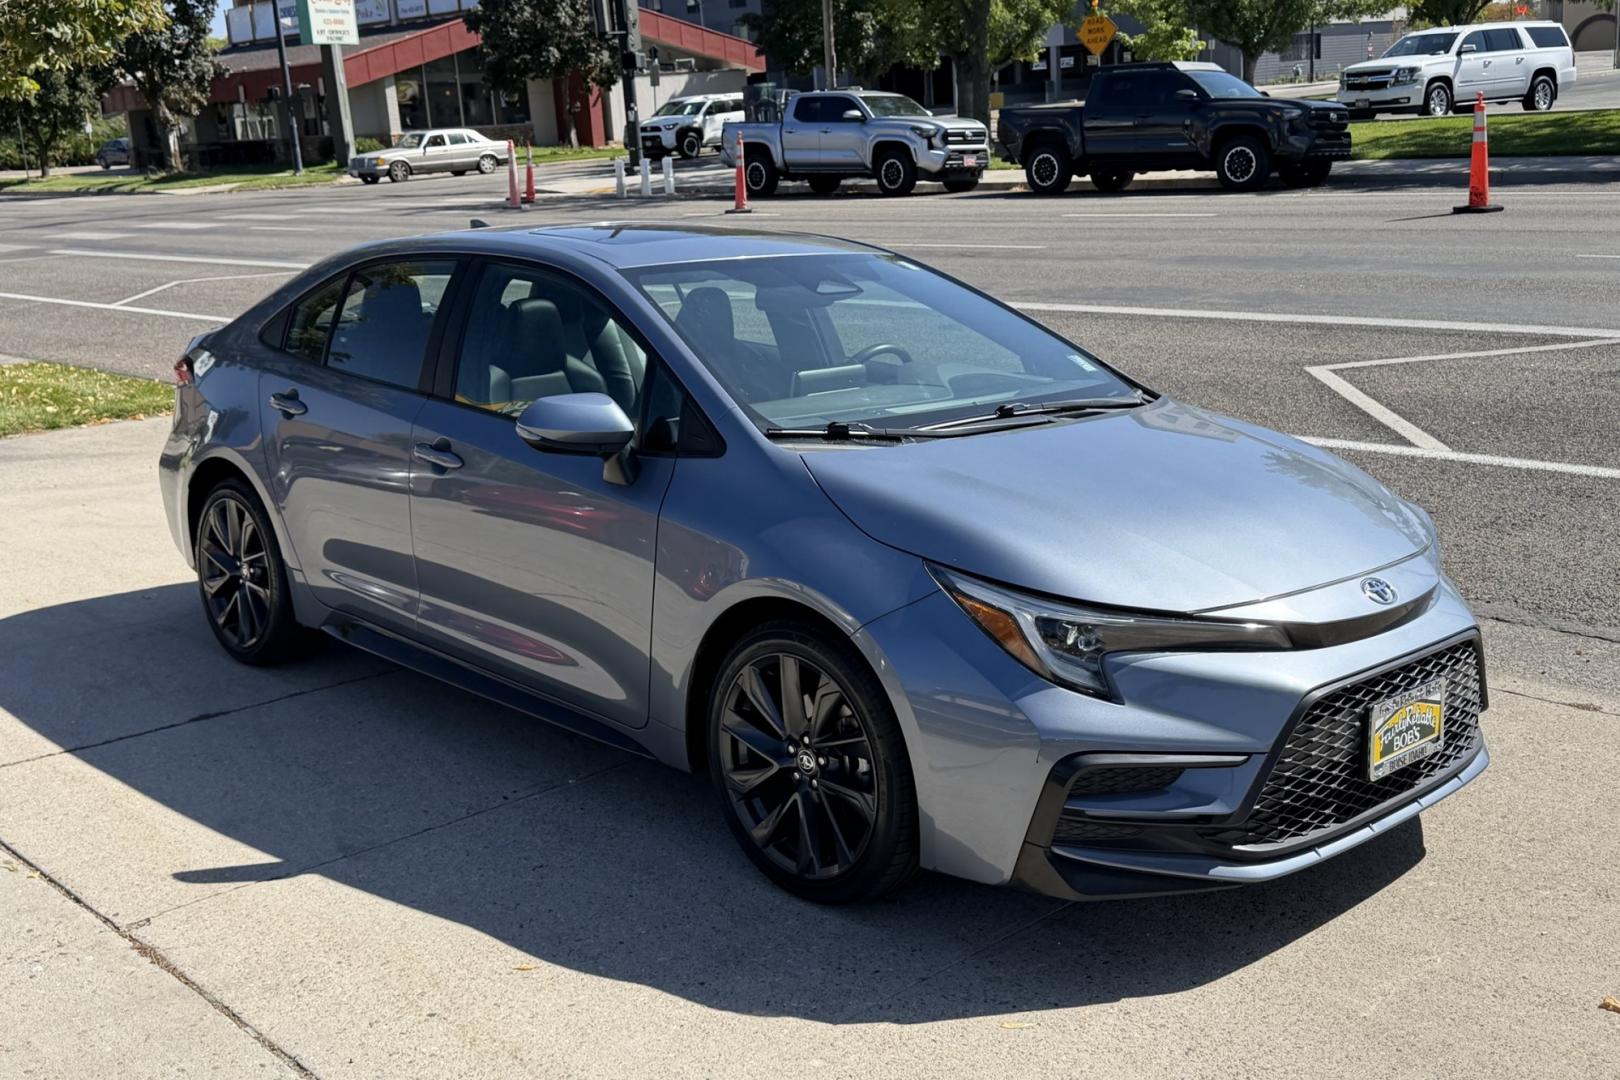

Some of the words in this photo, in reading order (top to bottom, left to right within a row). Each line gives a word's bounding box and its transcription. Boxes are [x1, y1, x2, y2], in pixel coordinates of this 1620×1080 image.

[1087, 17, 1105, 25] ROAD
[1380, 714, 1407, 752] Fairly
[1406, 705, 1437, 728] Reliable
[1393, 726, 1421, 751] BOB'S
[1389, 754, 1408, 772] BOISE
[1408, 745, 1427, 762] IDAHO
